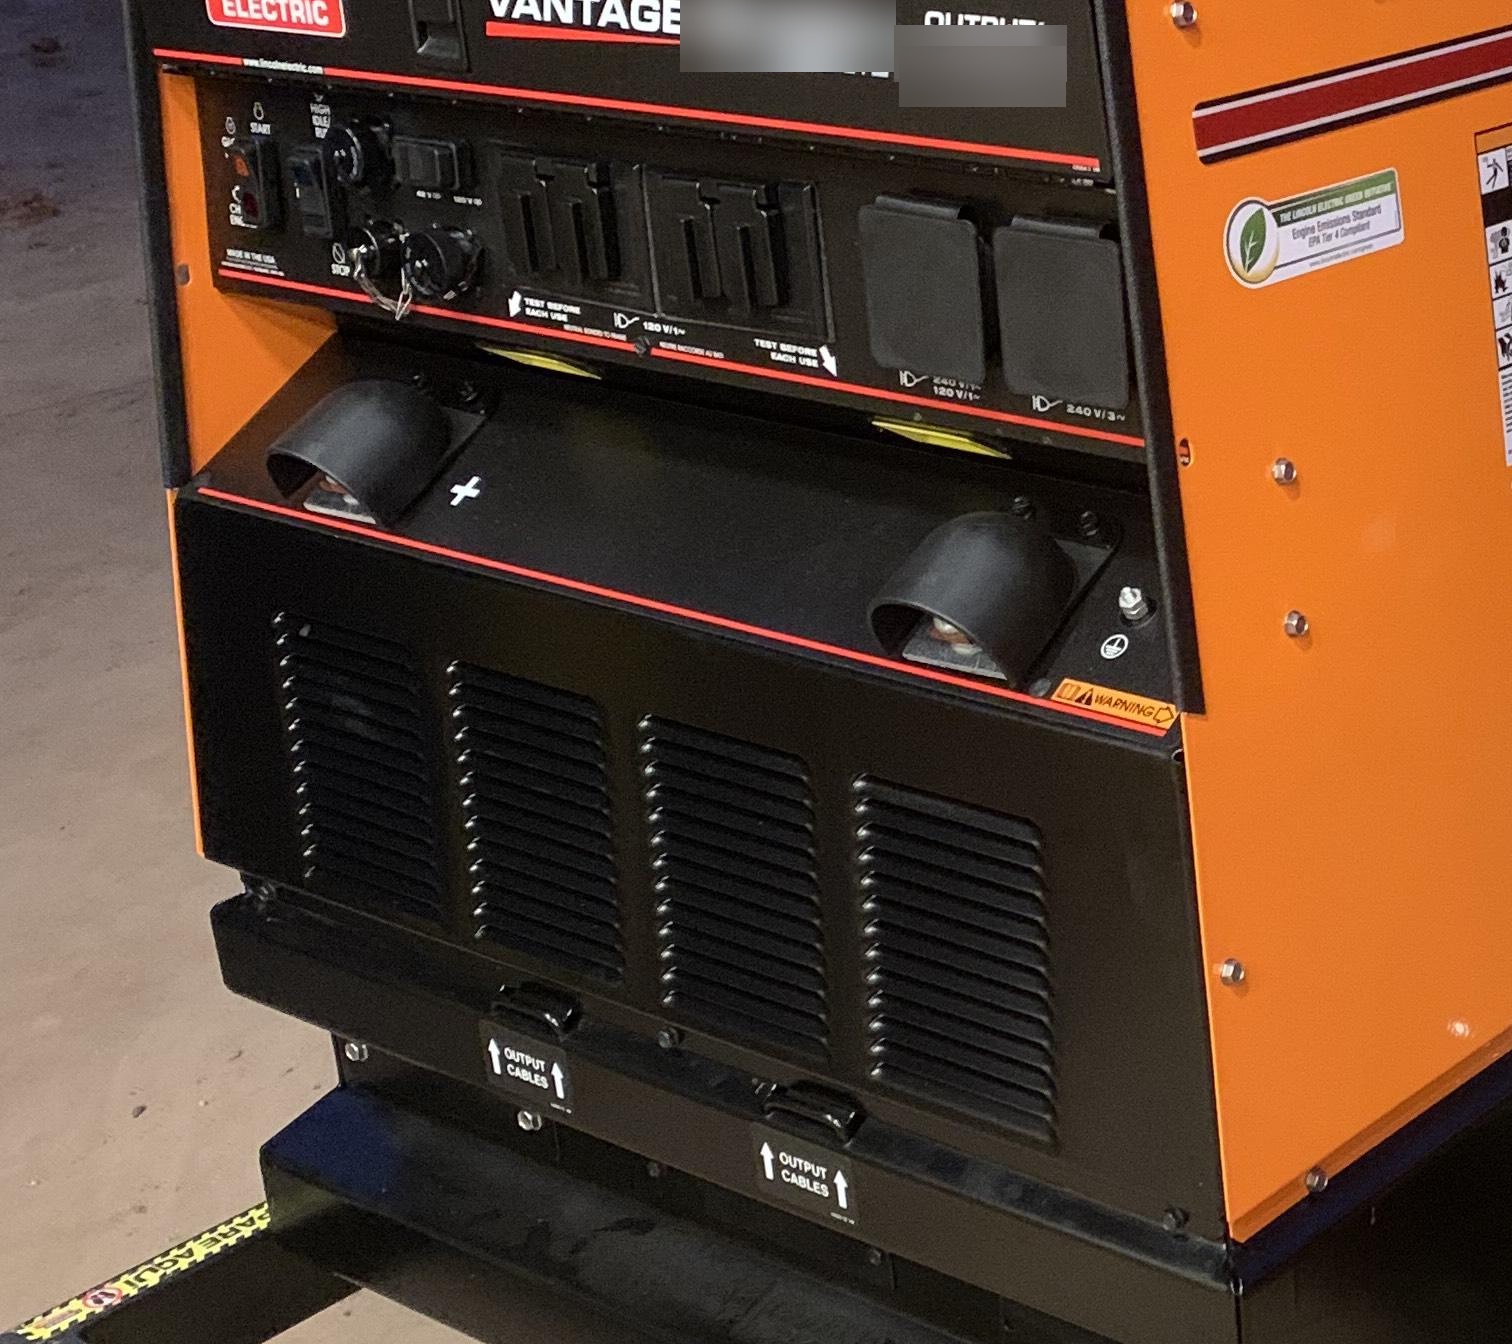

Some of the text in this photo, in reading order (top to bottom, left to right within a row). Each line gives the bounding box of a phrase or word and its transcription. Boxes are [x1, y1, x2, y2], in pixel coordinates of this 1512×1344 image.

[250, 122, 271, 135] START
[1292, 224, 1316, 240] Engine
[1317, 215, 1352, 232] Emissions
[1309, 236, 1321, 248] EPA
[523, 297, 581, 315] TEST BEFORE
[525, 307, 568, 323] EACH USE
[643, 321, 662, 333] 120
[754, 338, 818, 358] TEST BEFORE
[770, 351, 819, 369] EACH USE
[933, 386, 954, 398] 120
[1066, 404, 1091, 417] 240
[1094, 687, 1155, 717] WARNING
[504, 1047, 546, 1073] OUTPUT
[506, 1063, 549, 1090] CABLES
[779, 1151, 828, 1180] OUTPUT
[781, 1170, 830, 1198] CABLES
